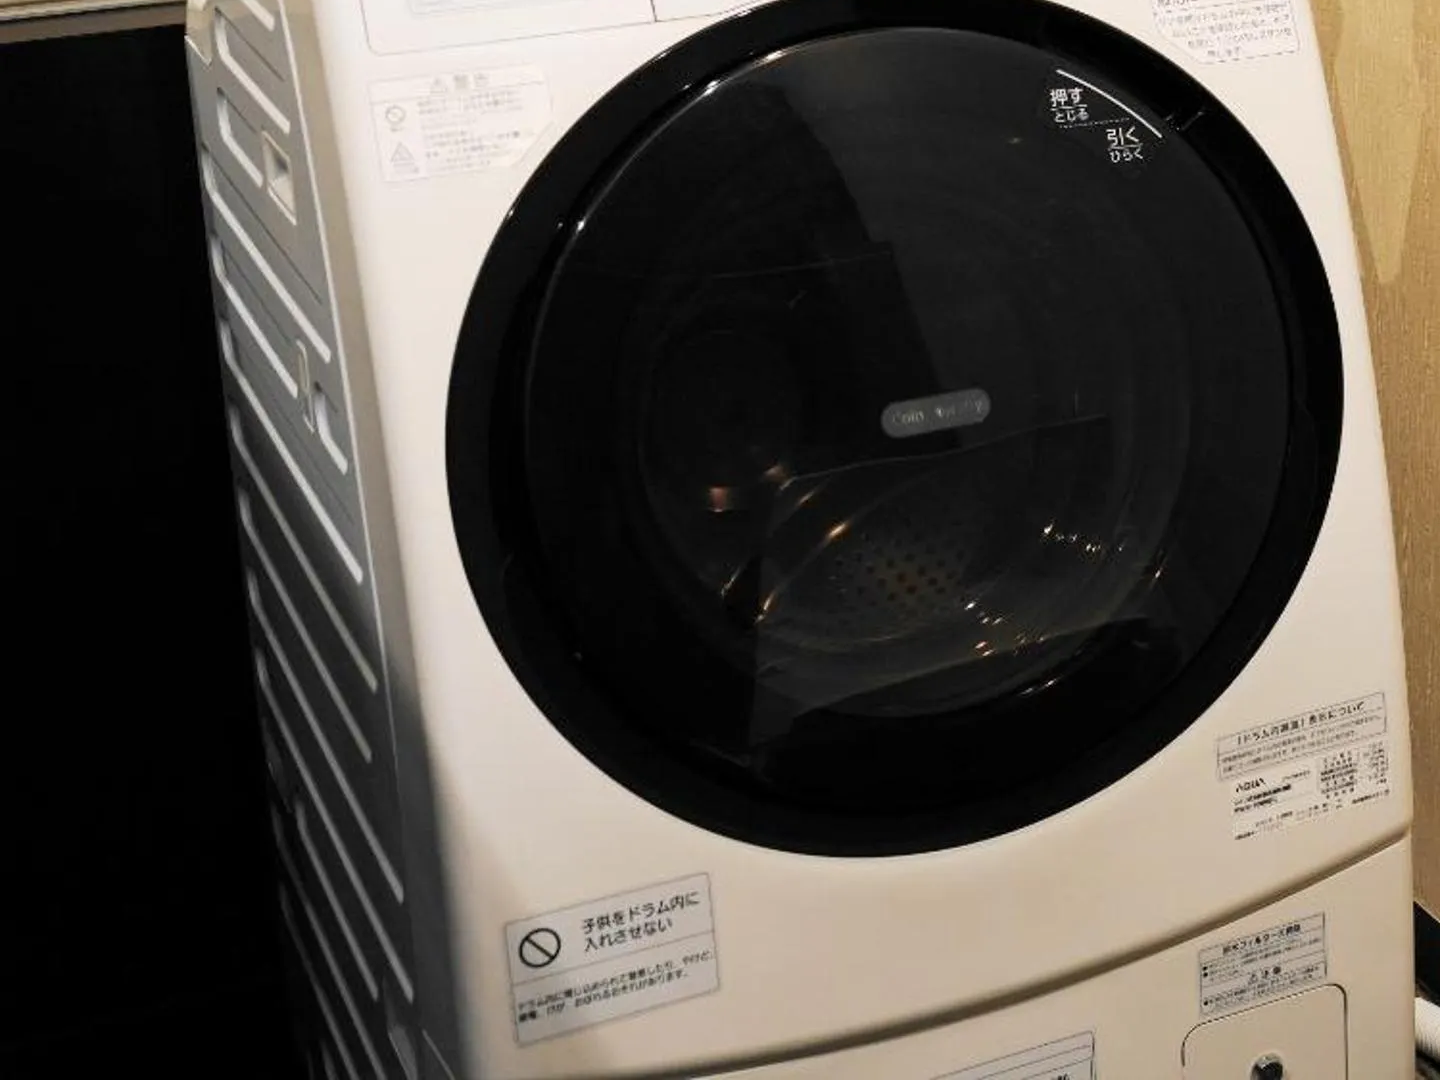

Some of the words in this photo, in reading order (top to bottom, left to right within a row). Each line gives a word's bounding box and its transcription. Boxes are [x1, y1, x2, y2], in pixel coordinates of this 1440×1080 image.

[1051, 87, 1084, 107] 押す
[1055, 108, 1090, 123] とじる
[1106, 126, 1141, 147] 引く
[1110, 147, 1144, 164] ひらく
[582, 891, 700, 935] 子供をドラム内に
[584, 918, 673, 953] 入れさせない
